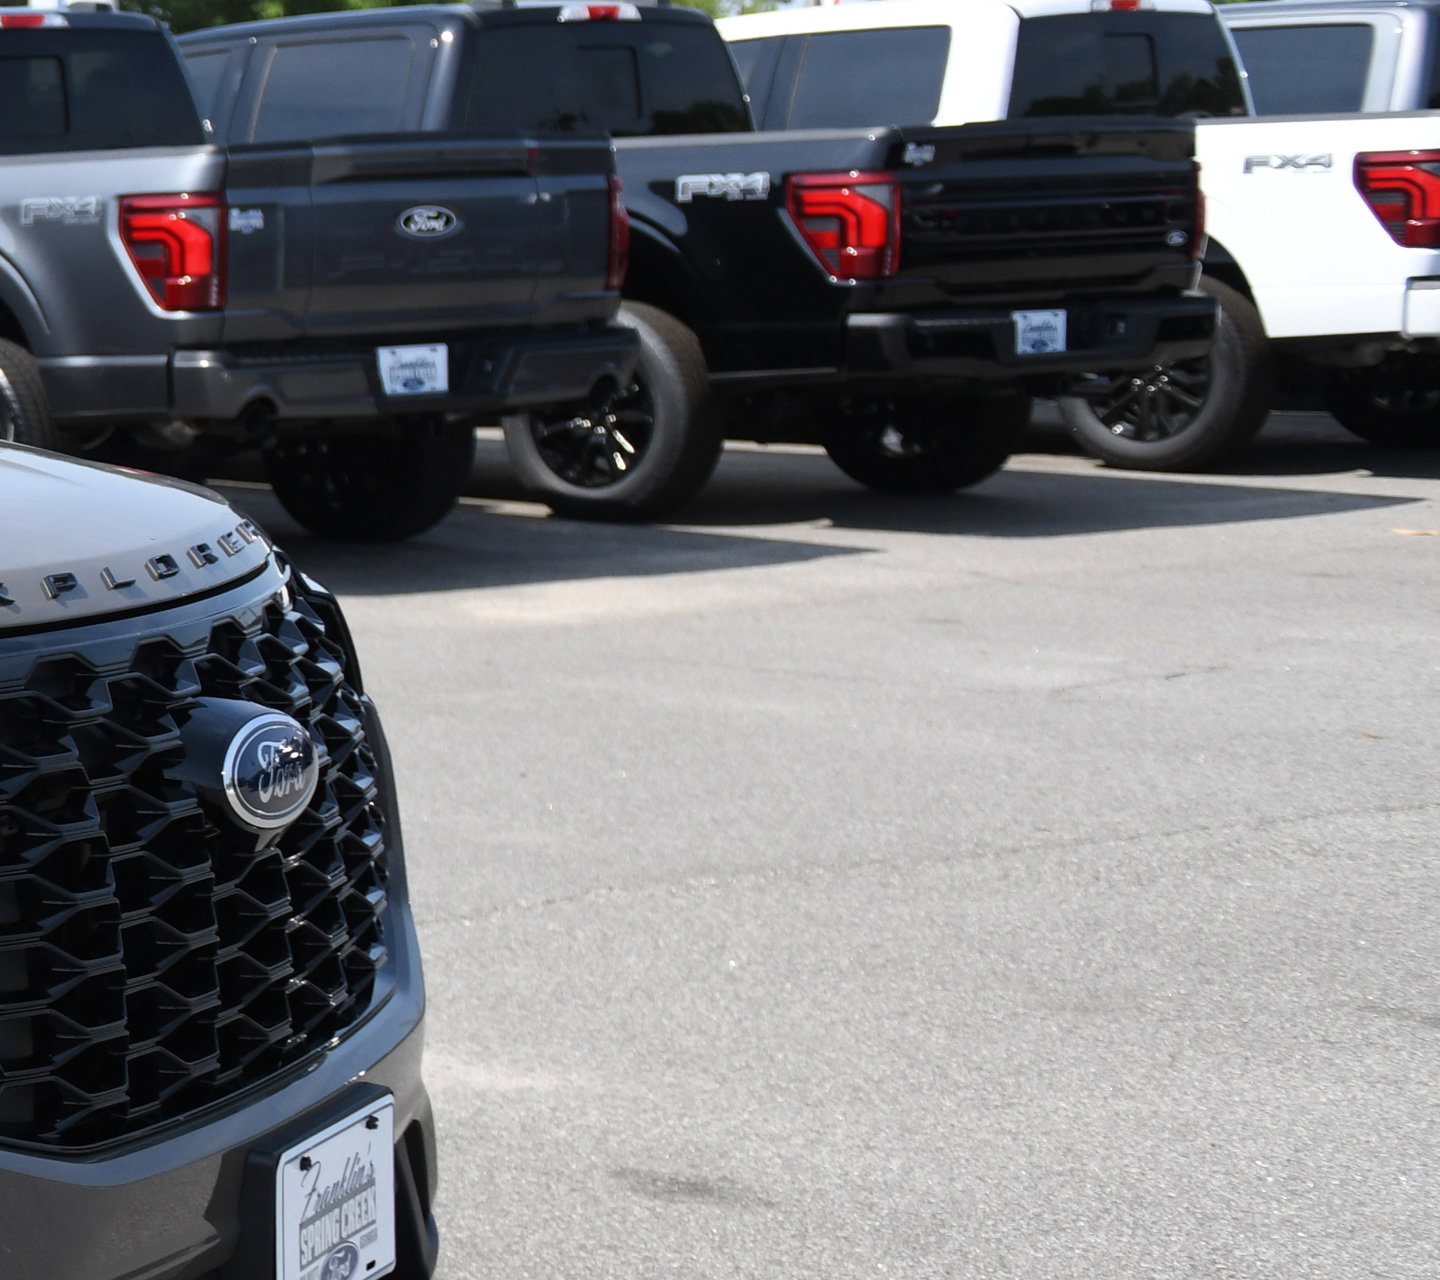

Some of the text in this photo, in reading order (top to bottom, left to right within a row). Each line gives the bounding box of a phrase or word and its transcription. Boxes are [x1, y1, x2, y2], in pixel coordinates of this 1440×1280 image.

[1242, 152, 1333, 174] FX4
[675, 171, 770, 203] FX4
[21, 195, 103, 226] FX4
[409, 209, 447, 232] Ford
[257, 738, 307, 805] Ford
[300, 1140, 375, 1222] Franklin's
[300, 1183, 376, 1266] SPRING CREEK
